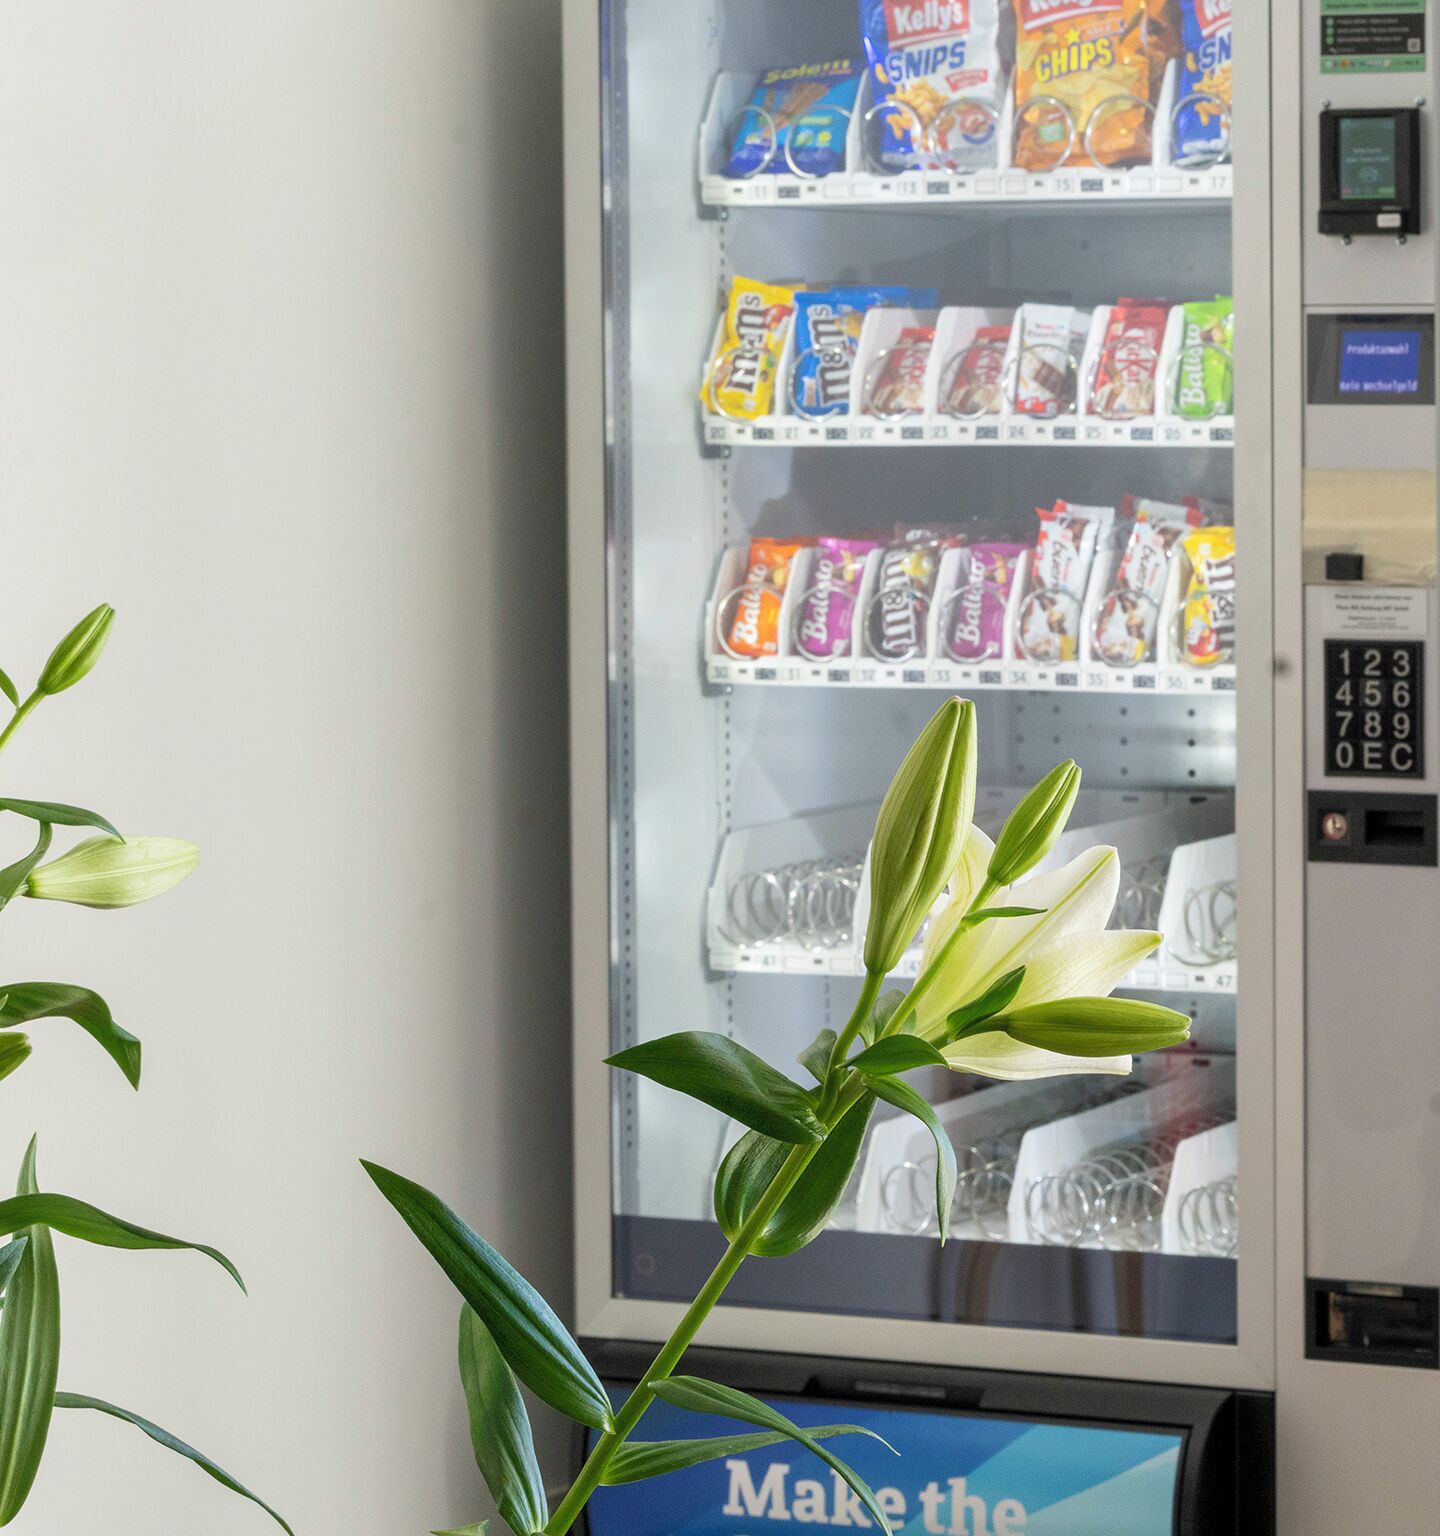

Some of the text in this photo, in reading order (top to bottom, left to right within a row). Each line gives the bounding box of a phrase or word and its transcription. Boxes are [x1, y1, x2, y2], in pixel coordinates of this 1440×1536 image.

[886, 42, 966, 82] SNIPS
[1035, 38, 1114, 82] CHIPS
[1339, 649, 1411, 677] 1 2 3
[1335, 680, 1411, 708] 4 5 6
[1336, 711, 1411, 739] 7 8 9
[1335, 742, 1413, 771] 0 E C
[722, 1459, 1027, 1536] Make the
